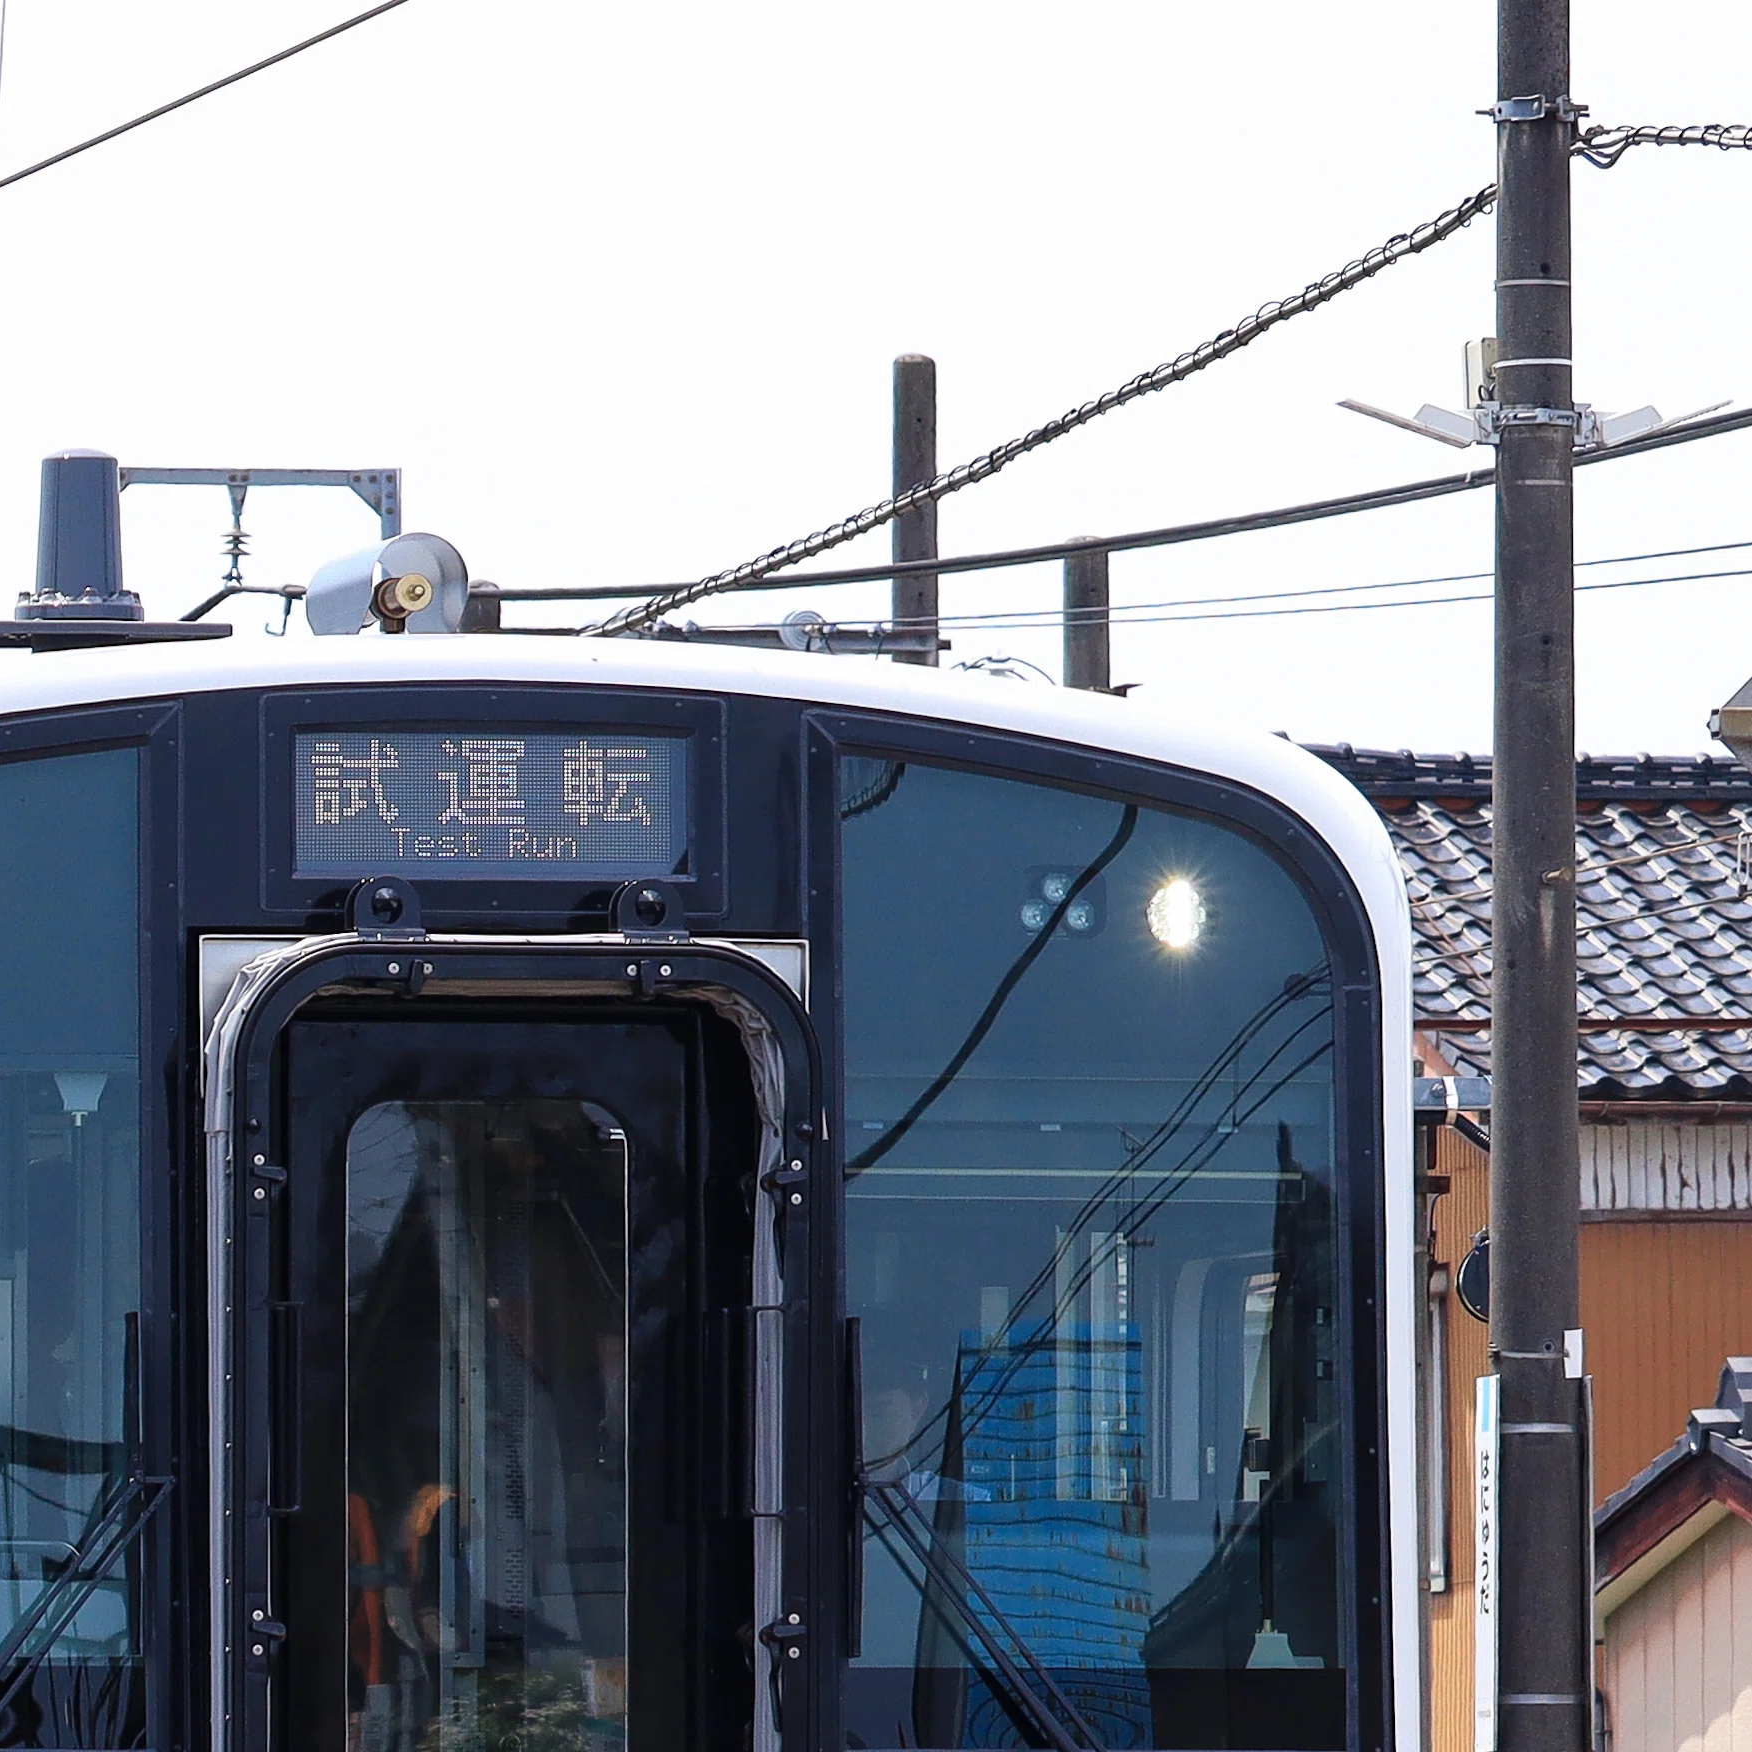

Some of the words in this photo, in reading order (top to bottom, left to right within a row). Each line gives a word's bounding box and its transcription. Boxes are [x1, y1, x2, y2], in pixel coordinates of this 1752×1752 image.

[310, 738, 652, 826] 試運転
[390, 827, 482, 858] Test
[507, 827, 579, 859] Run
